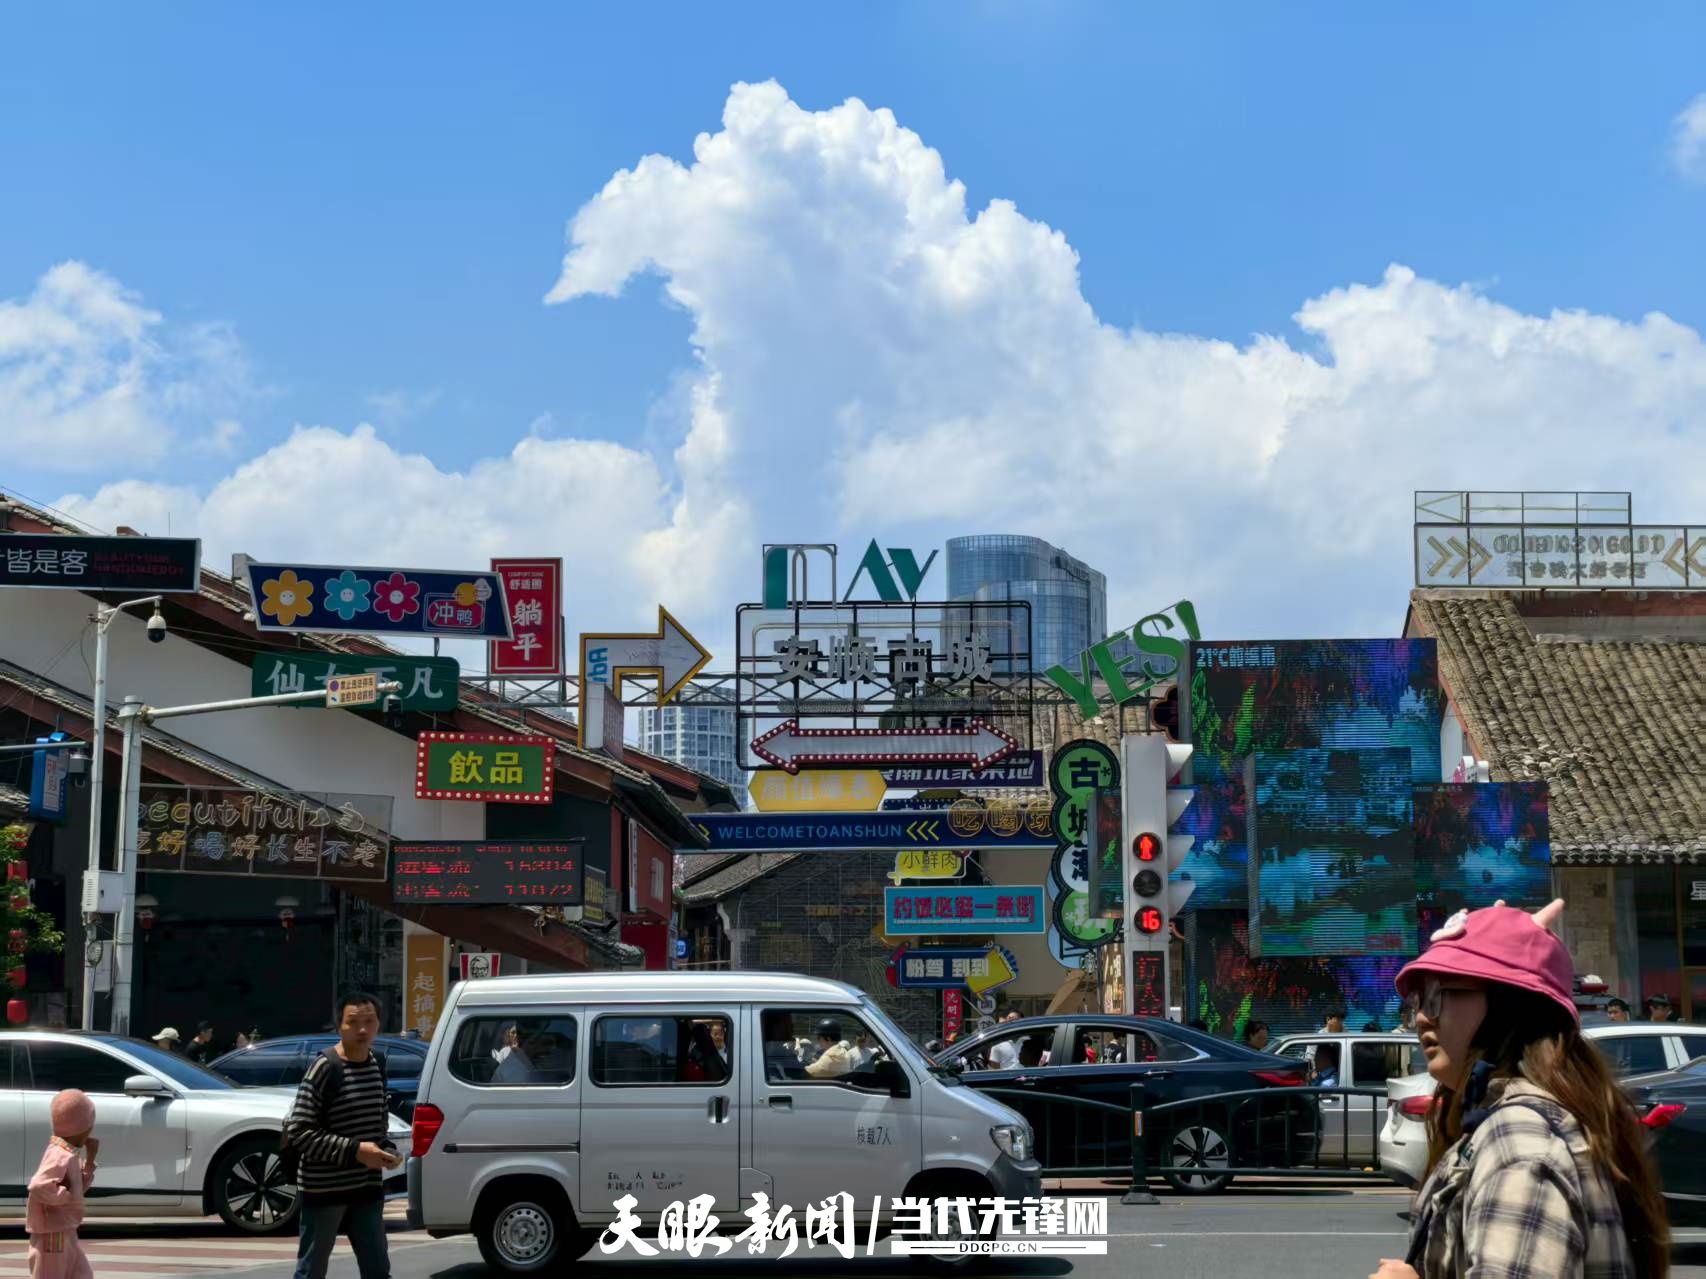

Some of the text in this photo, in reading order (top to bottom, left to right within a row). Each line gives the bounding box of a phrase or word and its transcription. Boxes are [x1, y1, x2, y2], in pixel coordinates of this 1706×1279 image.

[0, 549, 88, 575] 皆是客
[432, 602, 472, 625] 冲鸭
[512, 599, 543, 661] 躺平
[772, 632, 992, 684] 安顺古城
[1043, 599, 1201, 720] YES!
[448, 750, 524, 785] 飲品
[718, 823, 901, 839] WELCOMETOANSHUN
[903, 852, 958, 869] 小鲜肉
[1142, 910, 1160, 931] 16
[856, 1126, 891, 1145] 核载7人
